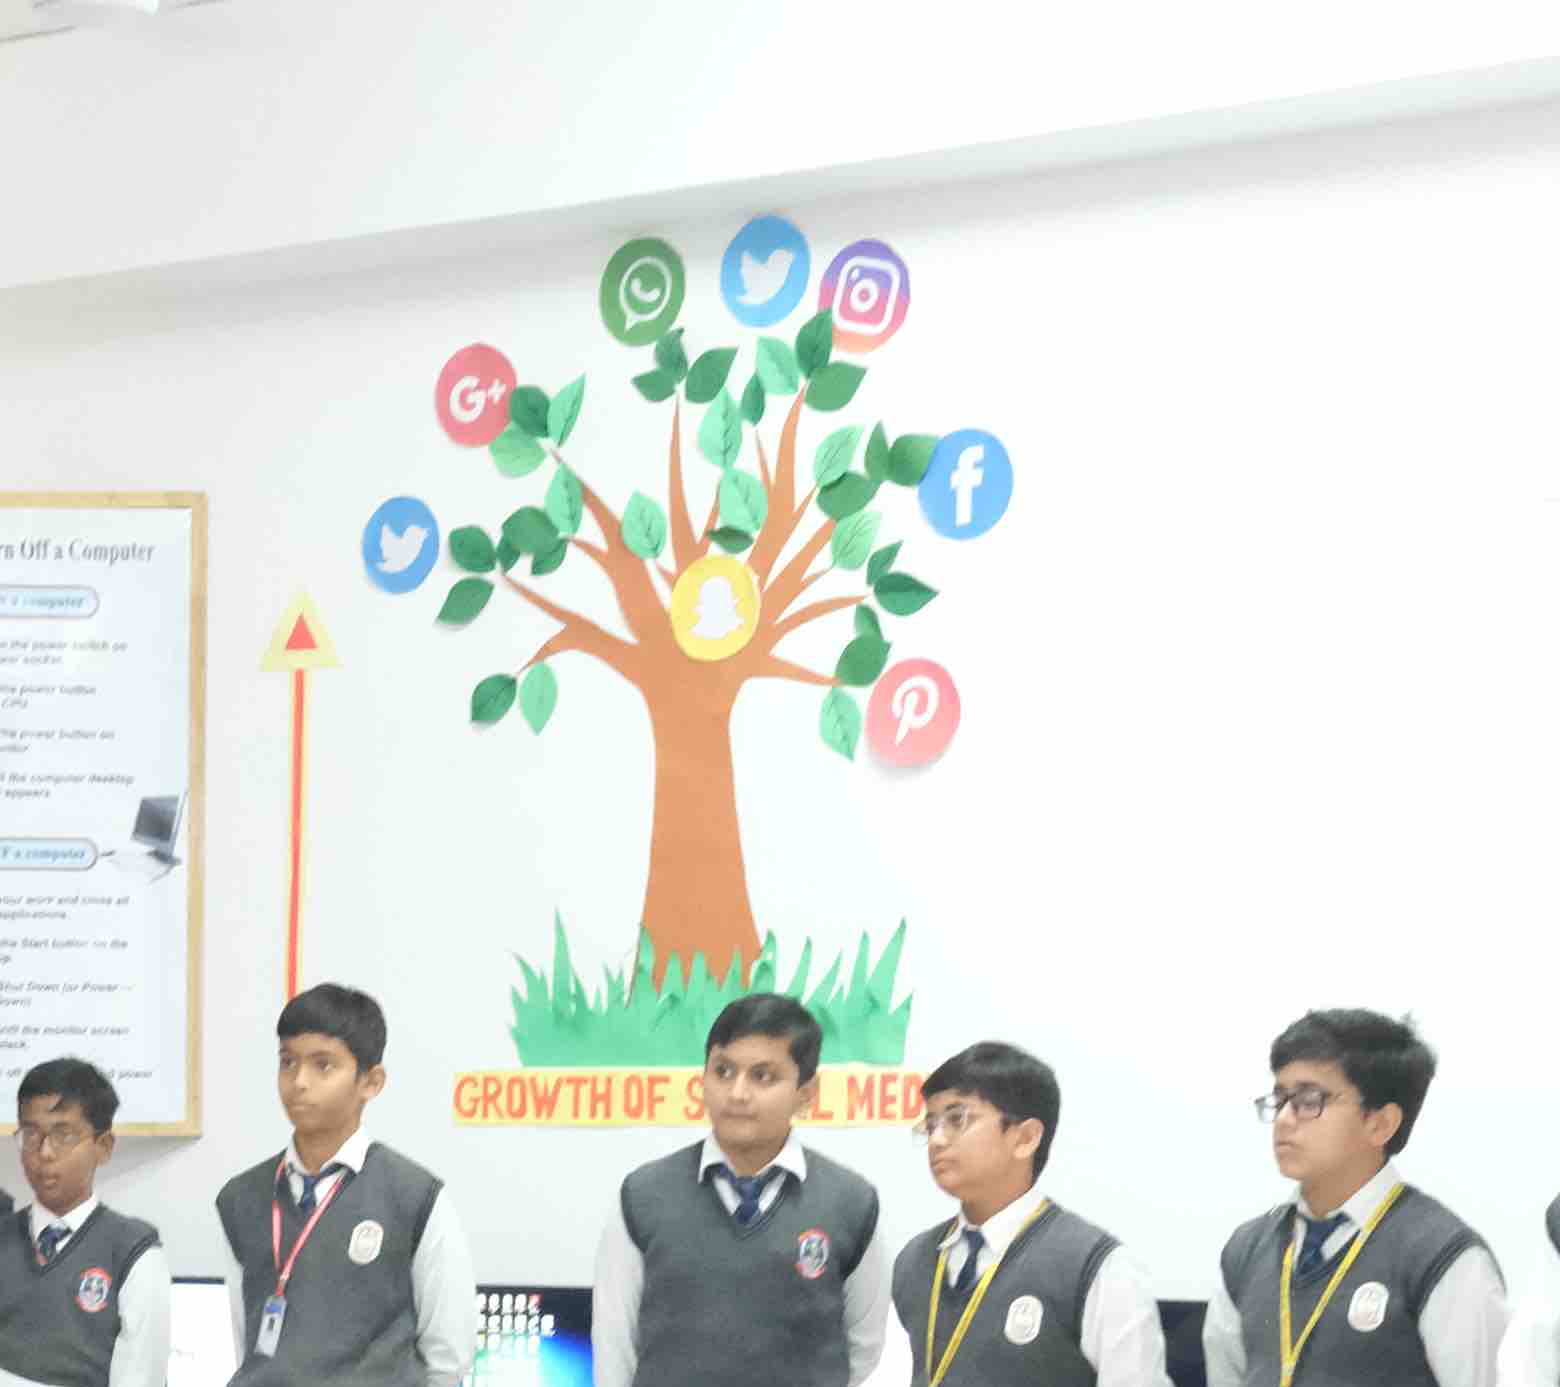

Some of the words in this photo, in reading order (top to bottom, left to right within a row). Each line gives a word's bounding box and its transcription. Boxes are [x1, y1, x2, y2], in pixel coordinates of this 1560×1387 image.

[19, 538, 51, 561] Off
[54, 545, 63, 560] a
[68, 538, 156, 567] Computer
[454, 1074, 613, 1120] GROWTH
[623, 1074, 670, 1121] OF
[846, 1074, 925, 1121] MED
